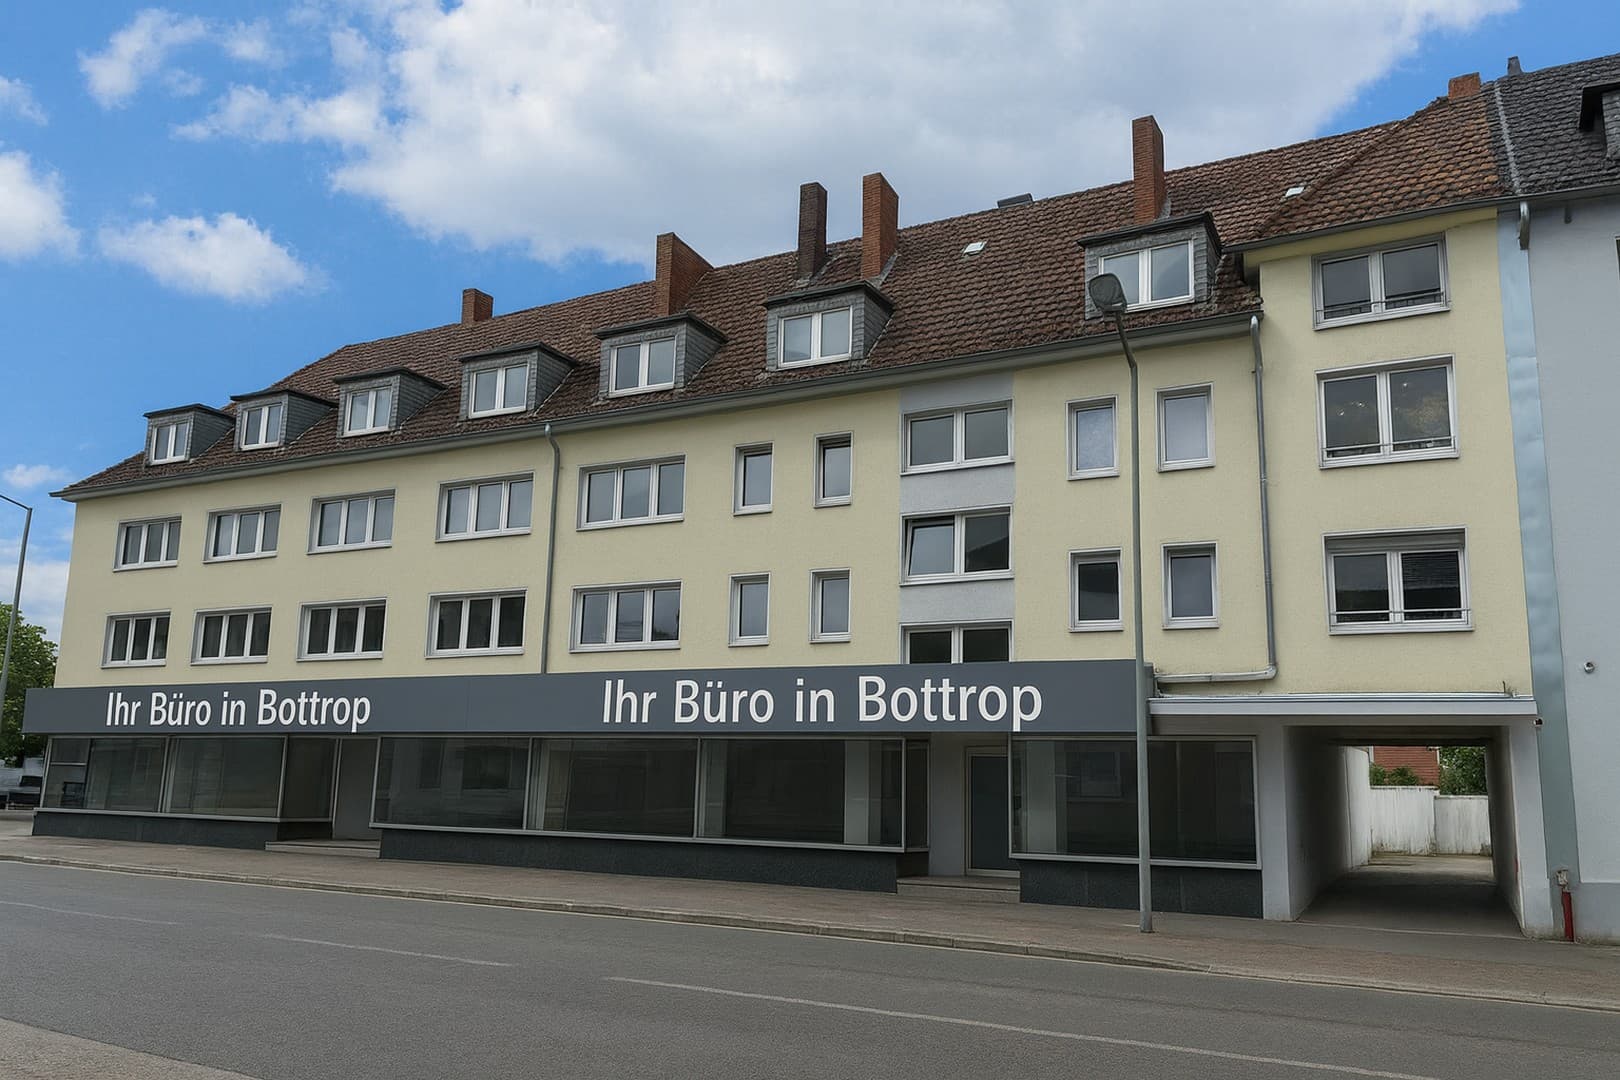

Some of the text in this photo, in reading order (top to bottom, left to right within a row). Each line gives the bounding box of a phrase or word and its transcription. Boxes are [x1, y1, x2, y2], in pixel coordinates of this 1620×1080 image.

[106, 688, 371, 733] Ihr Büro in Bottrop
[603, 675, 1042, 734] Ihr Büro in Bottrop
